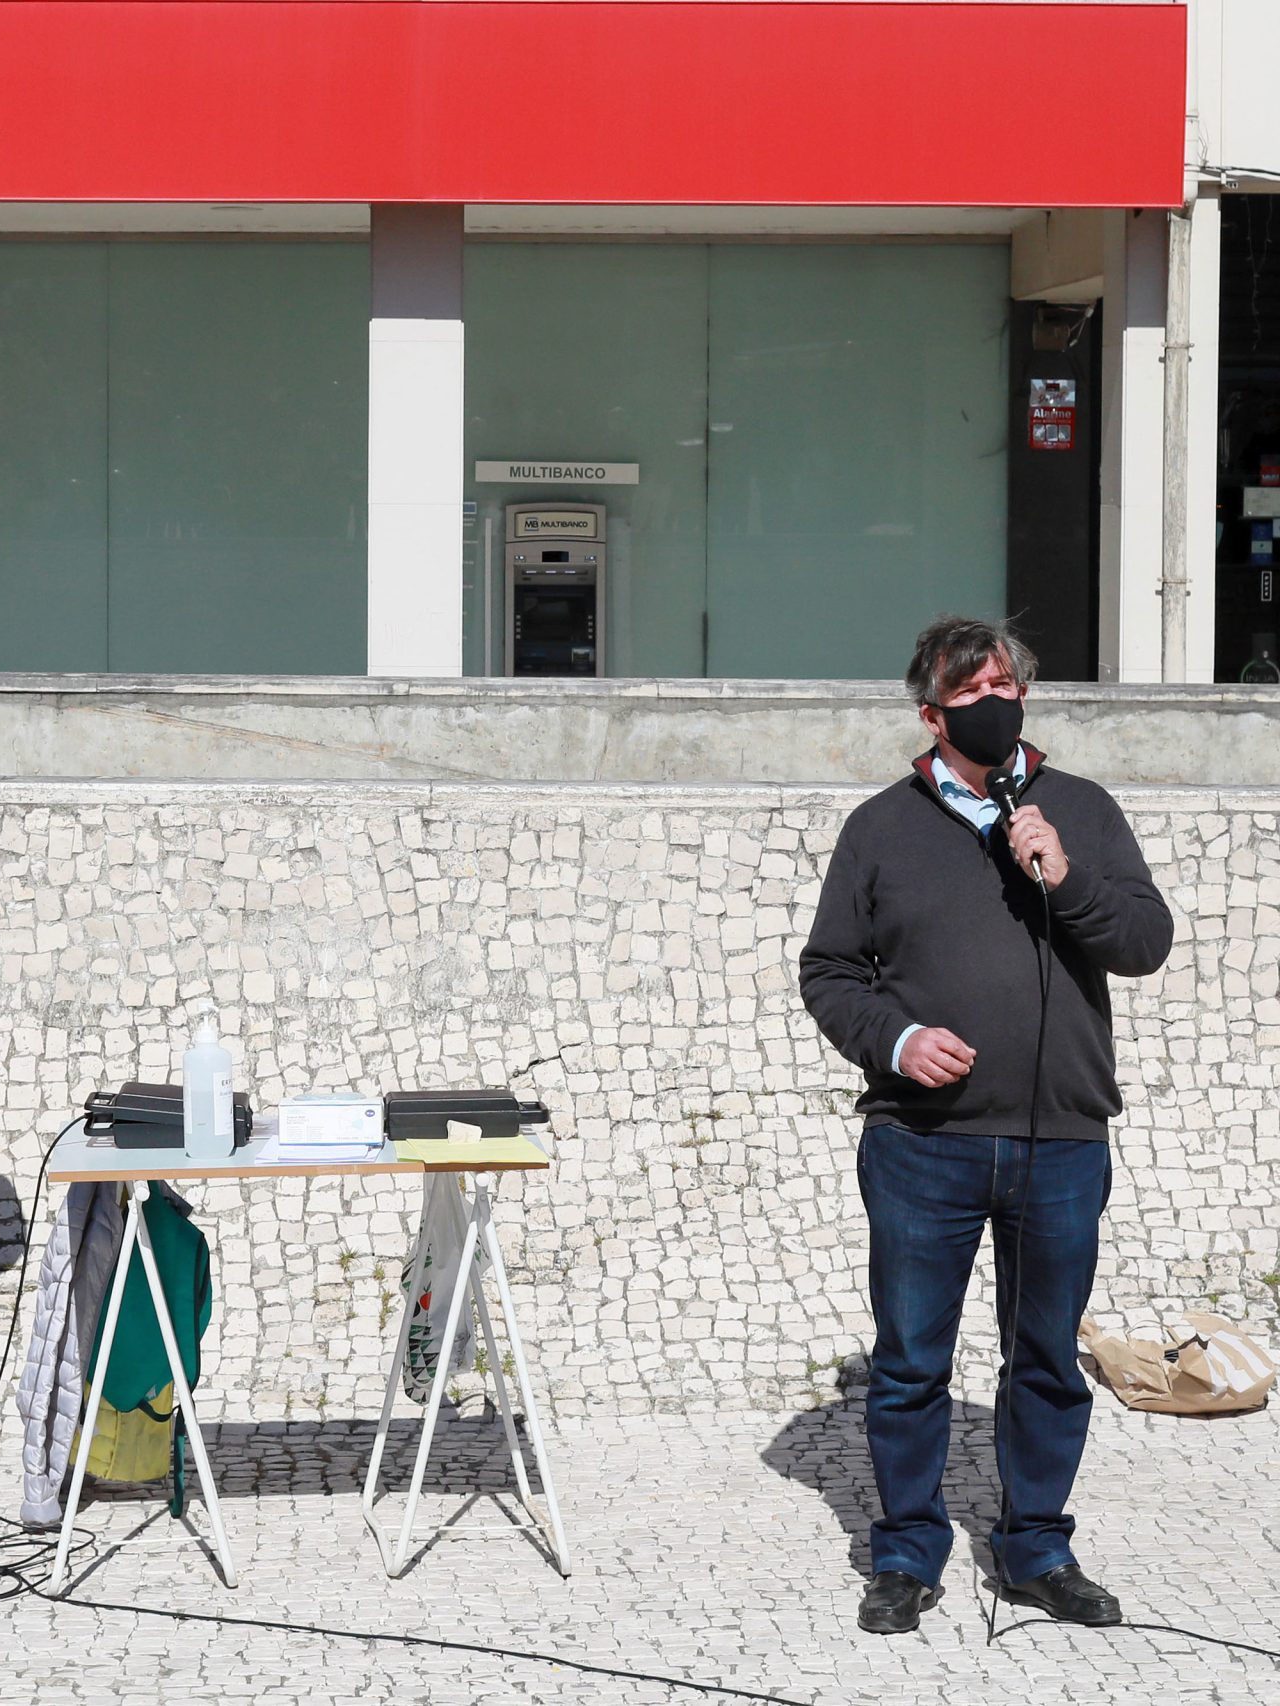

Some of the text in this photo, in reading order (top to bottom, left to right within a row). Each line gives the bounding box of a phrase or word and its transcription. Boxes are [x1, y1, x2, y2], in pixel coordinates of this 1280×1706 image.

[509, 466, 606, 479] MULTIBANCO
[524, 519, 588, 529] MB MULTIBANCO
